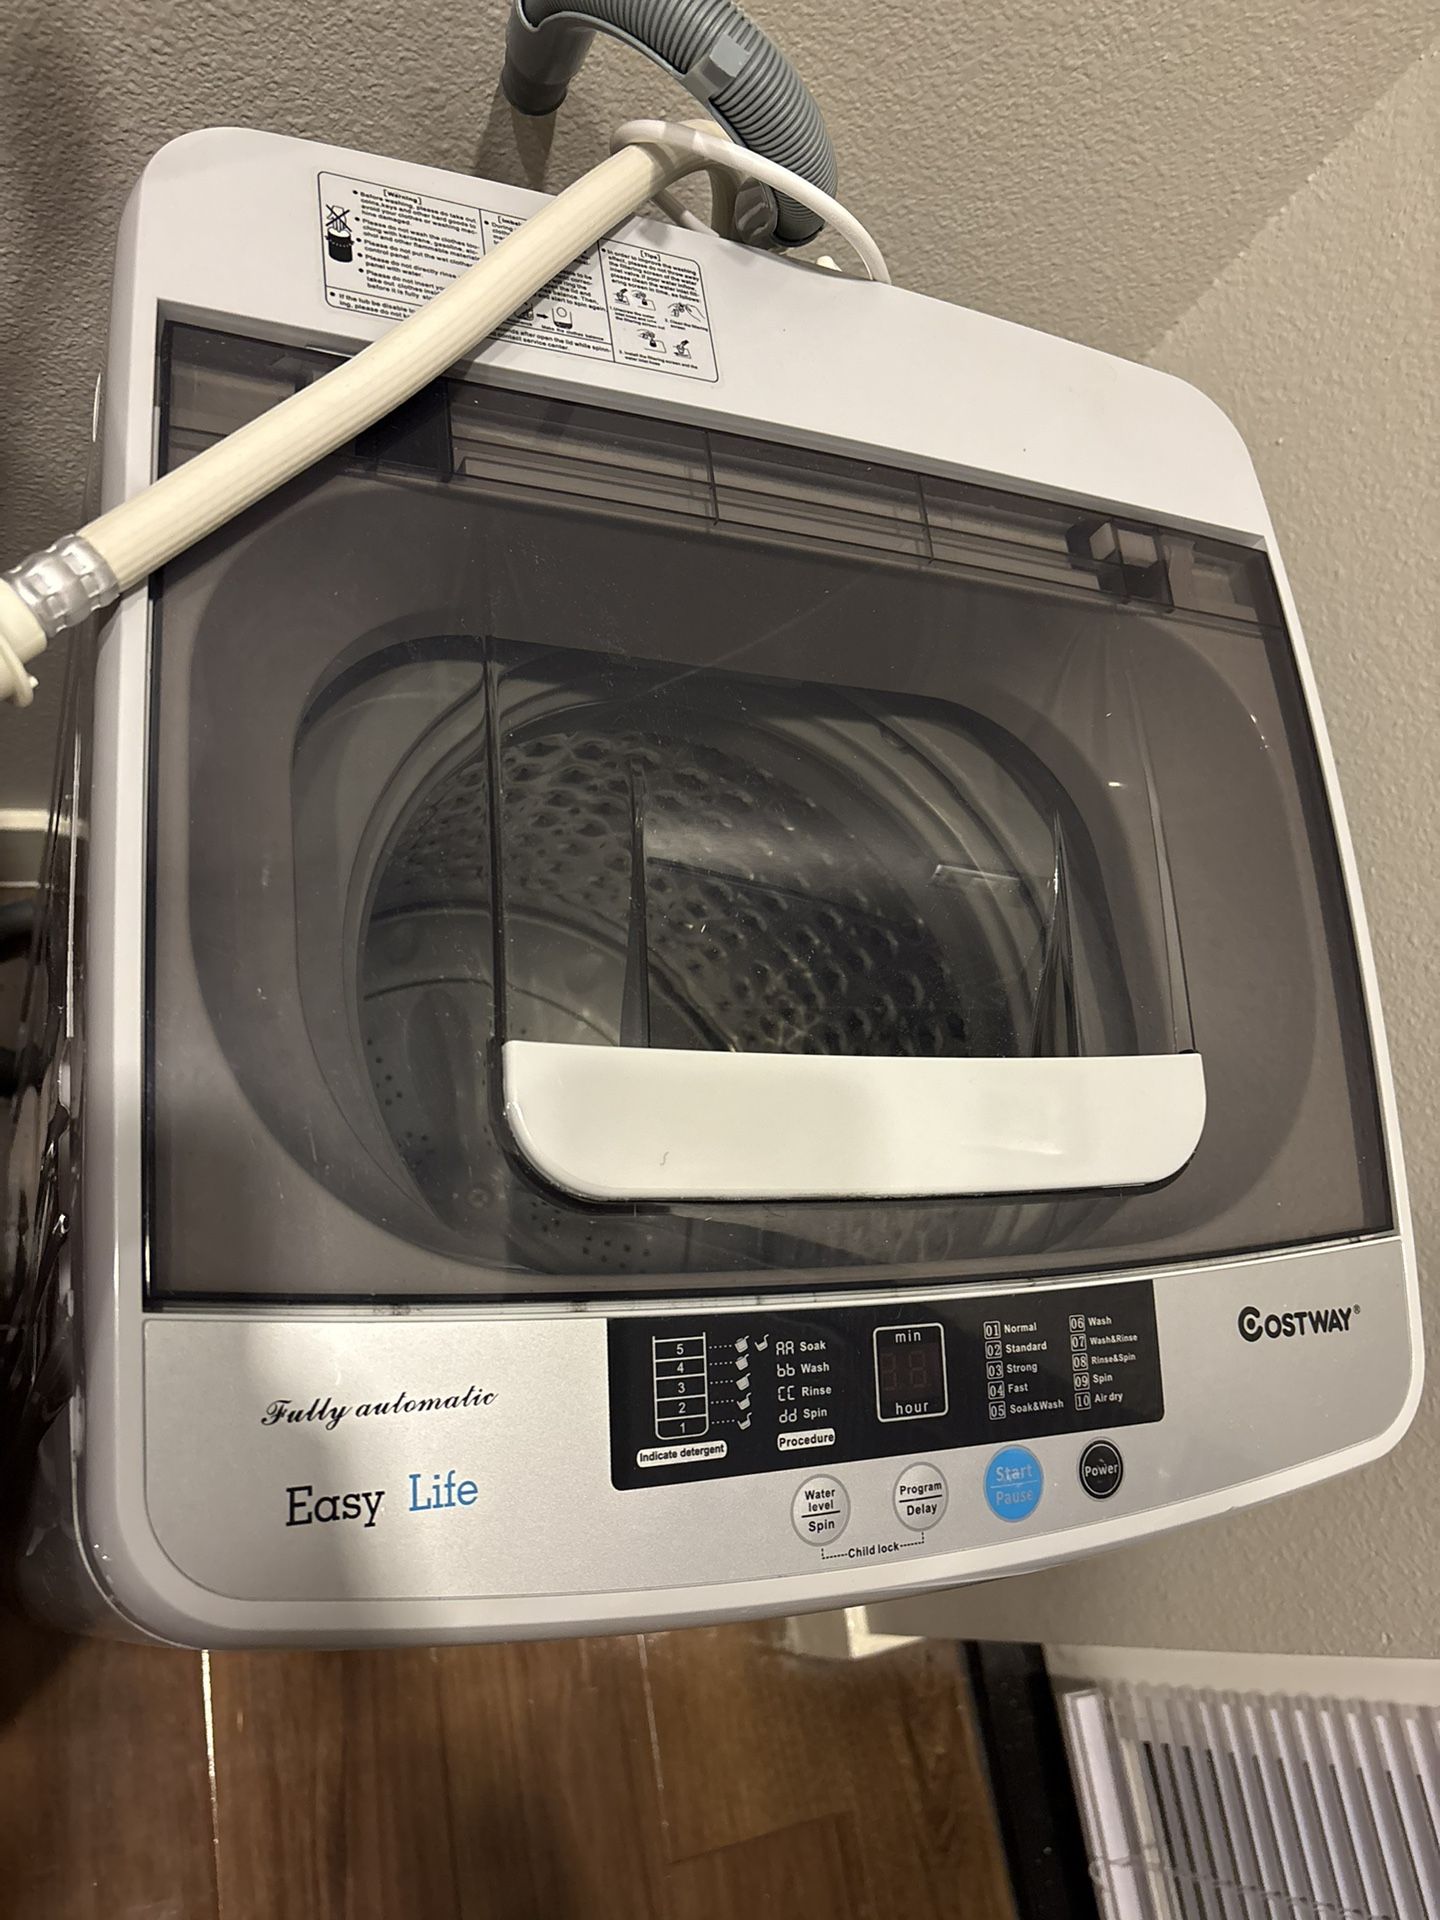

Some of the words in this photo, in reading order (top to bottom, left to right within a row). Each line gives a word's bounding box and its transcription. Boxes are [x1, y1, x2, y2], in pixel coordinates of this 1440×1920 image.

[986, 1324, 999, 1338] 01
[1004, 1322, 1037, 1334] Normal
[1070, 1317, 1084, 1330] 06
[1088, 1316, 1112, 1327] Wash
[895, 1330, 921, 1344] min
[1072, 1336, 1085, 1349] 07
[1090, 1333, 1138, 1346] Wash&Rinse
[676, 1343, 684, 1355] 5
[800, 1340, 826, 1352] Soak
[987, 1344, 1001, 1357] 02
[1006, 1340, 1047, 1354] Standard
[1073, 1355, 1086, 1368] 08
[1091, 1352, 1136, 1365] Rinse&Spin
[676, 1362, 684, 1374] 4
[800, 1362, 830, 1374] Wash
[988, 1364, 1002, 1378] 03
[1006, 1362, 1038, 1376] Strong
[677, 1382, 686, 1394] 3
[1074, 1375, 1088, 1388] 09
[1092, 1373, 1113, 1385] Spin
[802, 1384, 832, 1398] Rinse
[990, 1385, 1004, 1398] 04
[1008, 1382, 1028, 1394] Fast
[261, 1398, 353, 1431] Fully
[355, 1385, 499, 1418] automatic
[678, 1402, 686, 1414] 2
[991, 1405, 1004, 1418] 05
[1010, 1398, 1064, 1415] Soak&Wash
[1077, 1394, 1090, 1407] 10
[803, 1406, 828, 1420] Spin
[896, 1402, 928, 1416] hour
[679, 1423, 686, 1434] 1
[779, 1432, 834, 1448] Procedure
[640, 1449, 678, 1462] Indicate
[680, 1444, 724, 1458] detergent
[996, 1464, 1032, 1482] Start
[1084, 1463, 1118, 1478] Power
[804, 1487, 836, 1501] Water
[899, 1480, 942, 1496] Program
[286, 1485, 385, 1528] Easy
[408, 1470, 479, 1512] Life
[996, 1489, 1034, 1505] Pause
[808, 1498, 834, 1512] level
[906, 1502, 938, 1517] Delay
[808, 1519, 836, 1534] Spin
[848, 1545, 875, 1559] Child
[878, 1541, 900, 1555] lock
